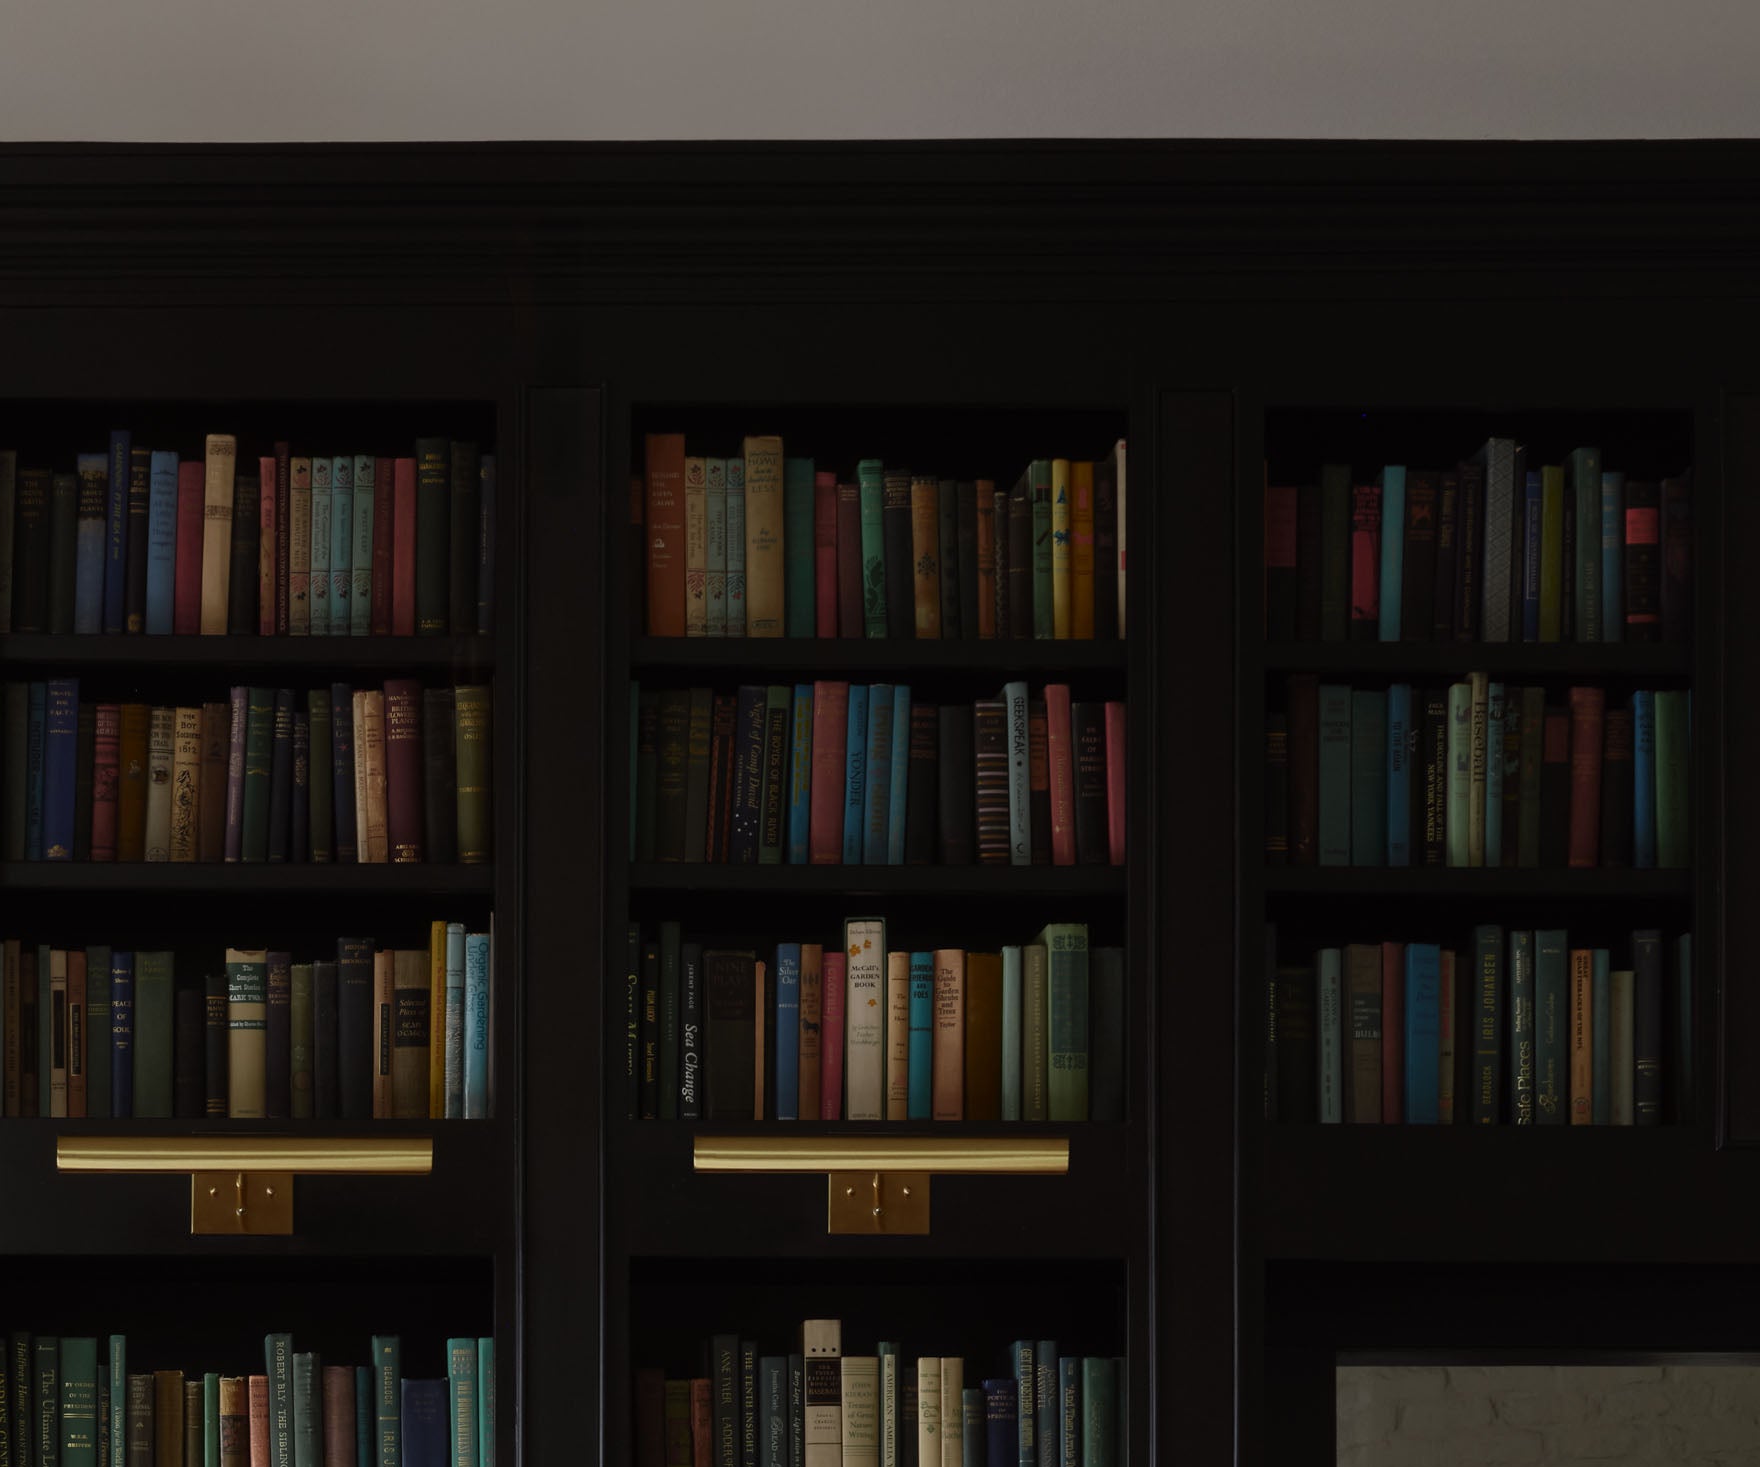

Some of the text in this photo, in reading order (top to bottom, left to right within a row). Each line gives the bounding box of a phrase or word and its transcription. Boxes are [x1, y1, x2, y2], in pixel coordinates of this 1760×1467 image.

[181, 721, 196, 730] BOY
[1014, 696, 1024, 756] GEEKSPEAK
[178, 745, 197, 754] 1812
[747, 745, 761, 808] Camp David
[475, 942, 486, 1050] Organic Gardening
[1483, 953, 1496, 1039] IRIS JOHANSEN
[682, 1024, 697, 1103] Sea Change
[42, 1370, 55, 1394] The
[277, 1342, 286, 1401] ROBERT BLY
[721, 1351, 731, 1404] ANNE TYLER
[745, 1351, 753, 1370] THE
[384, 1366, 393, 1405] DEADLOCK
[745, 1375, 753, 1407] TENTH
[42, 1400, 55, 1450] Ultimate
[278, 1410, 286, 1428] THE
[384, 1431, 394, 1453] IRIS
